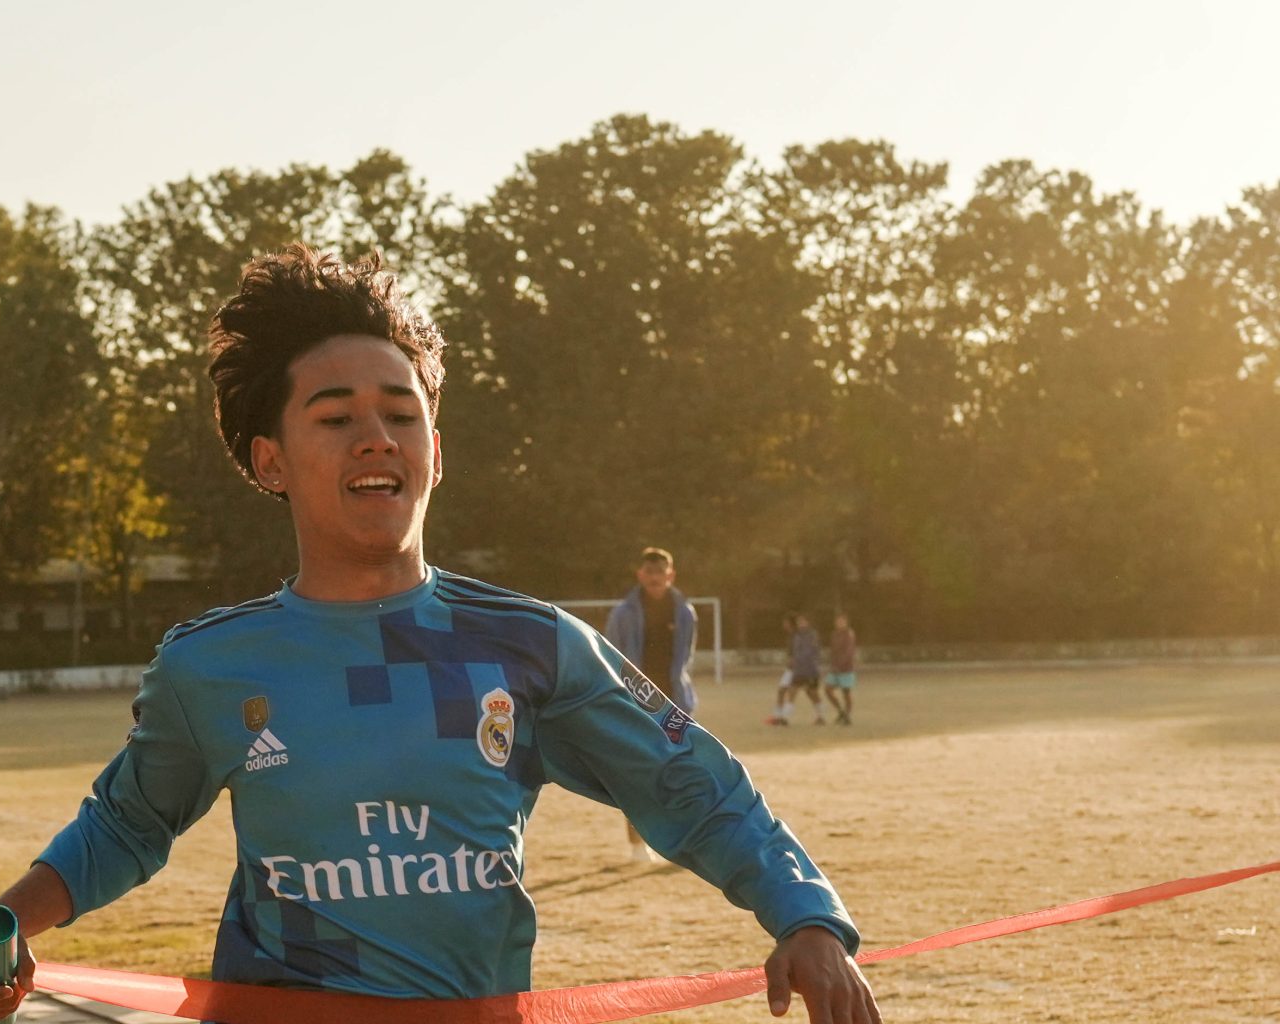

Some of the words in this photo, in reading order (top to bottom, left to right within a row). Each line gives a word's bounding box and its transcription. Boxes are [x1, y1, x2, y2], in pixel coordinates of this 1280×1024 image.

[637, 681, 656, 702] 12
[245, 753, 289, 772] adidas
[355, 800, 430, 841] Fly
[260, 843, 520, 902] Emirates
